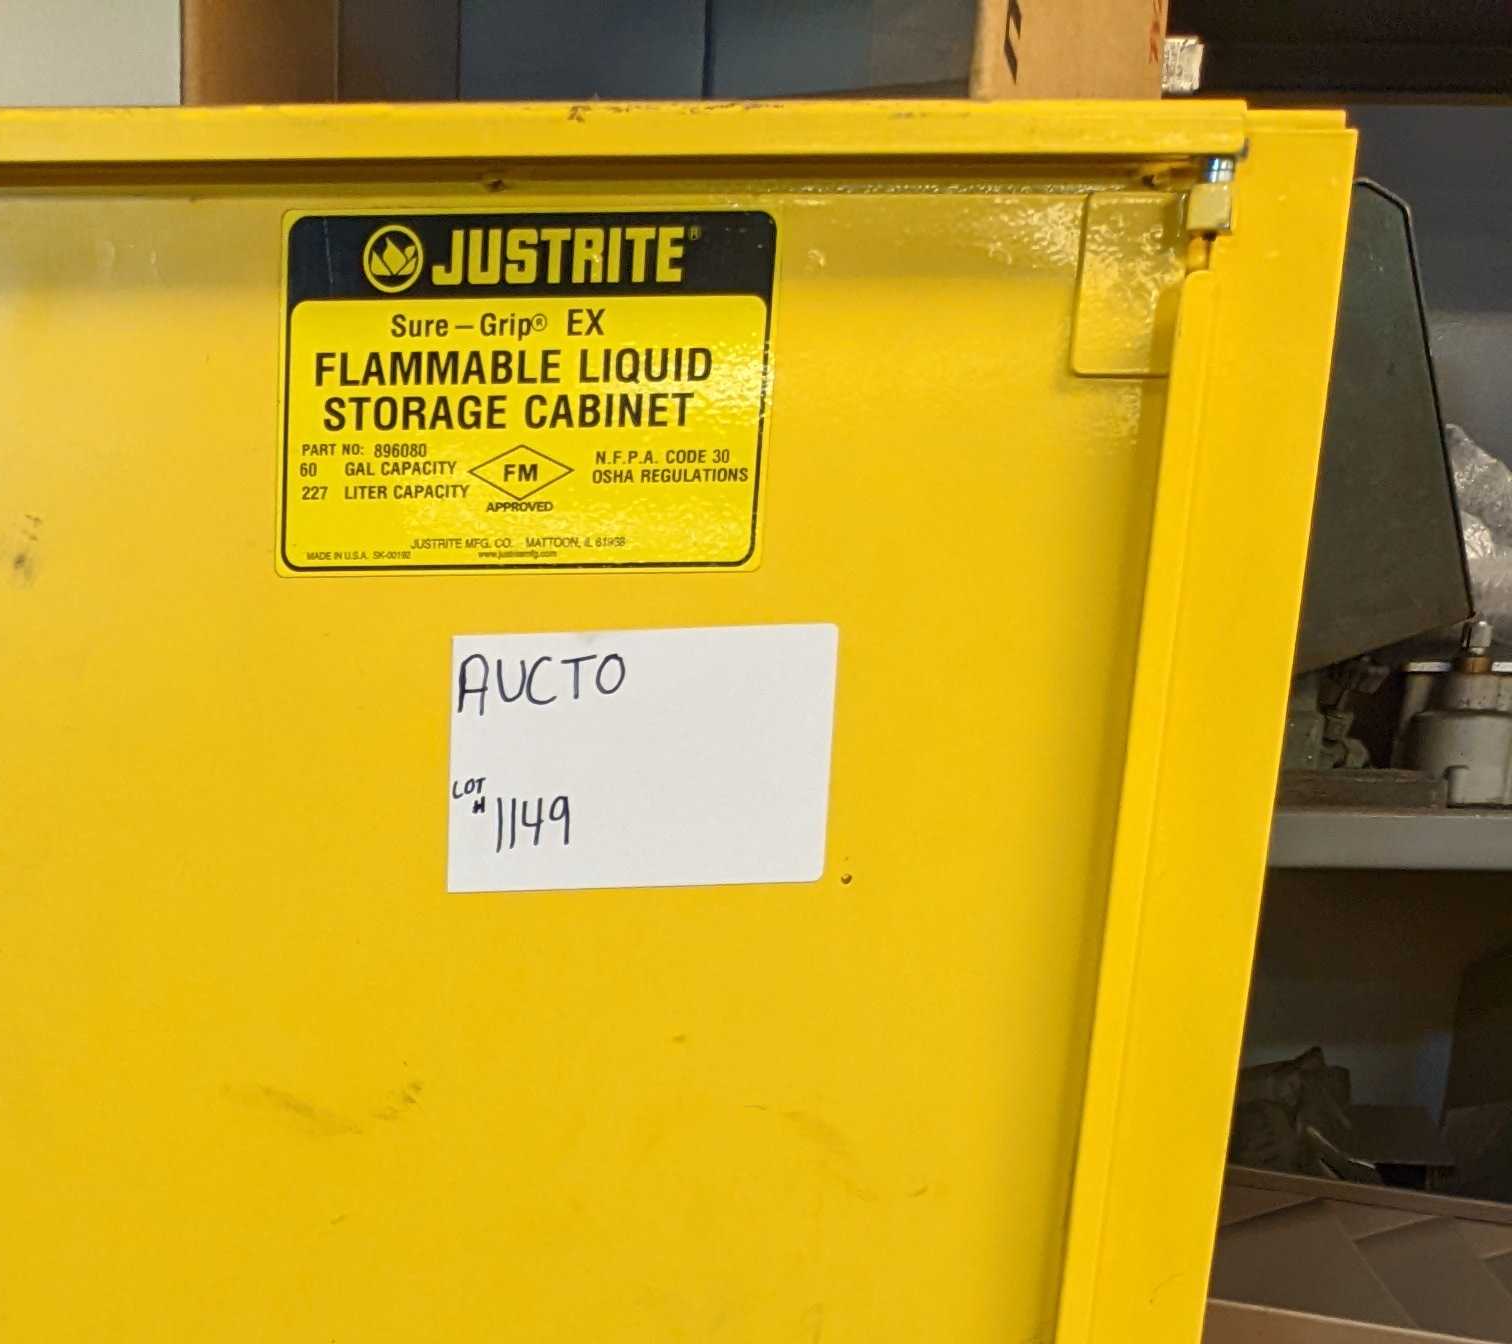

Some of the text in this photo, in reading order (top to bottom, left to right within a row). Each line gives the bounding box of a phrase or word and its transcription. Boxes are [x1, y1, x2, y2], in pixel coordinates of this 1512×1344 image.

[566, 308, 606, 337] EX
[314, 347, 713, 387] FLAMMABLE LIQUID
[322, 392, 695, 432] STORAGE CABINET
[301, 443, 428, 458] PART NO: 896080
[595, 449, 731, 466] N.F.P.A. CODE 30
[299, 460, 458, 478] 60 GAL CAPACITY
[503, 463, 539, 483] FM
[592, 467, 749, 484] OSHA REGULATIONS
[301, 484, 470, 501] 227 LITER CAPACITY
[485, 501, 554, 513] APPROVED
[410, 538, 462, 550] JUSTRITE
[306, 551, 331, 560] MADE
[334, 551, 342, 560] IN
[456, 652, 626, 717] AUCTO
[451, 777, 486, 799] LOT
